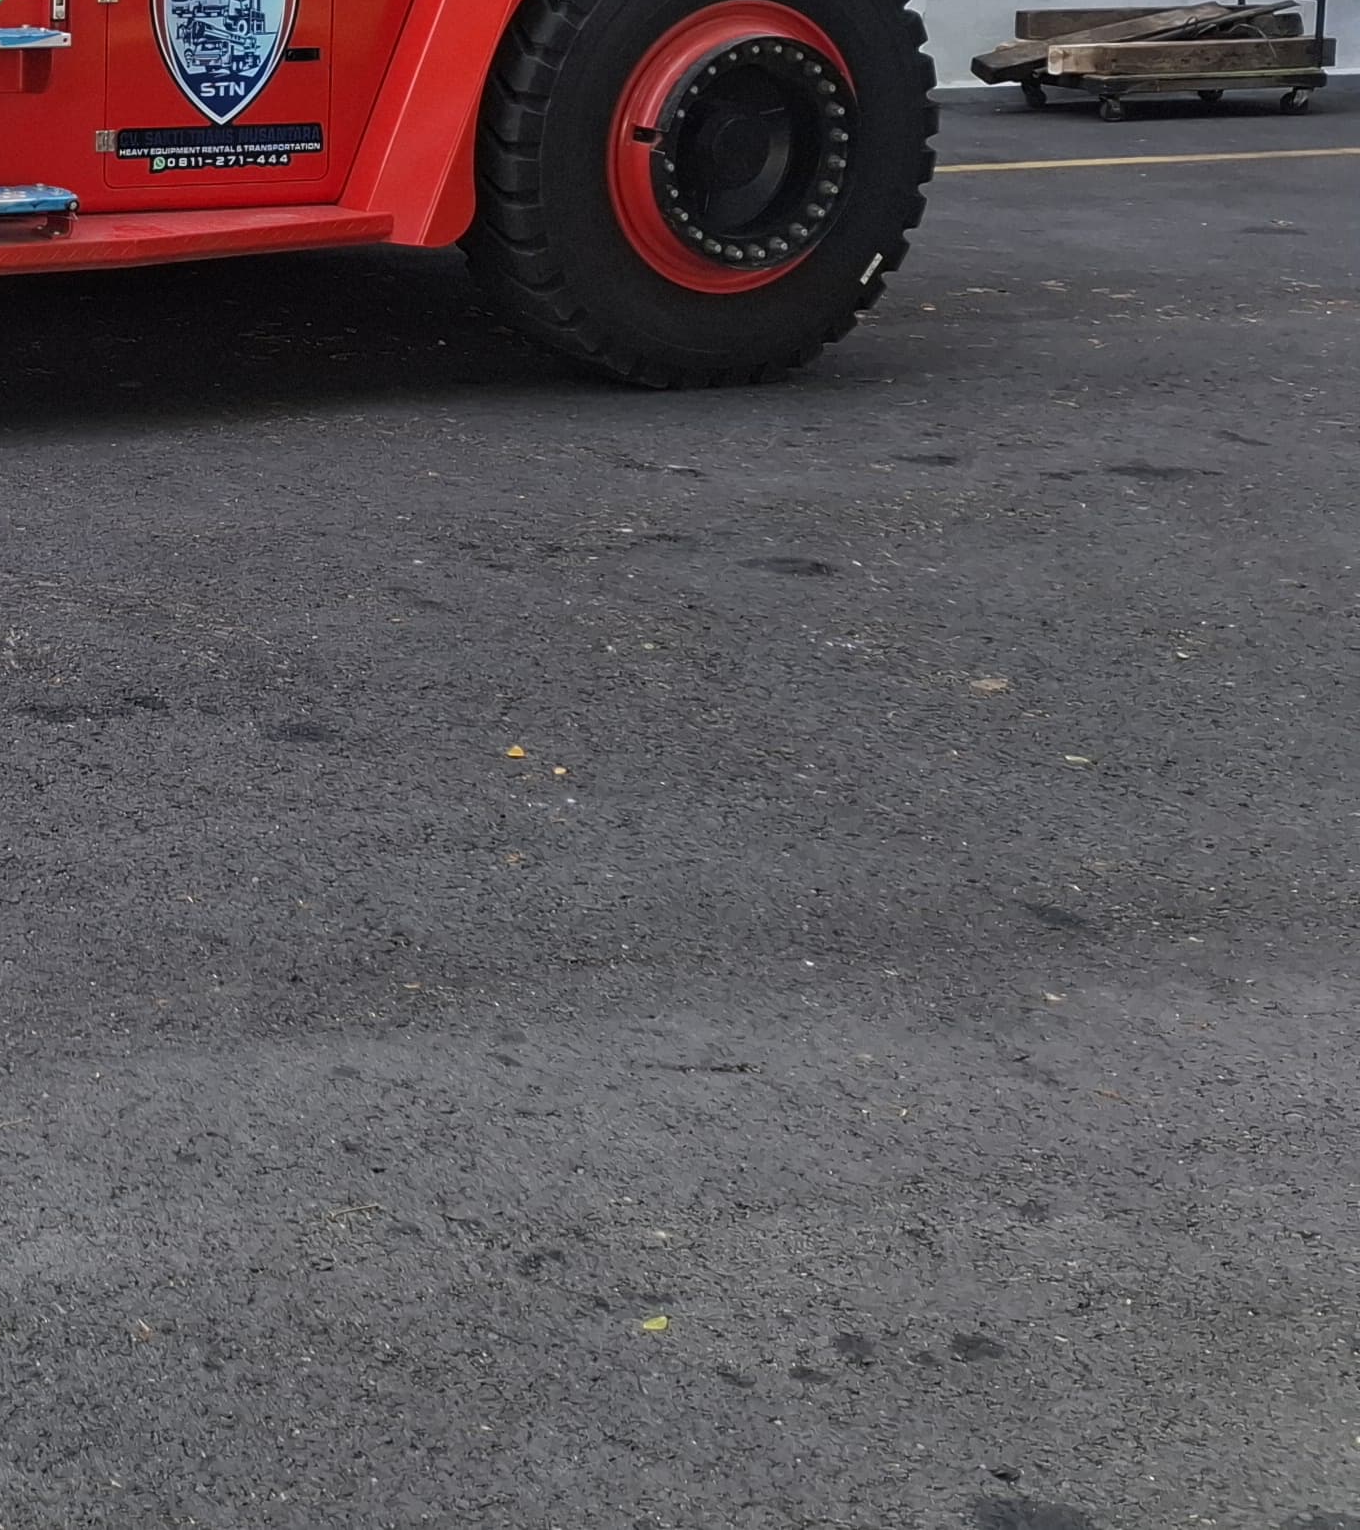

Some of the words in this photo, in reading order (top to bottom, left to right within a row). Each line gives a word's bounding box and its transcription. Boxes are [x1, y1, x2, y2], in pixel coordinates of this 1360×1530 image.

[200, 82, 245, 97] STN
[238, 126, 320, 143] NUSANTARA
[119, 148, 148, 157] HEAVY
[150, 146, 200, 155] EQUIPMENT
[201, 145, 235, 154] RENTAL
[244, 143, 320, 152] TRANSPORTATION
[167, 154, 289, 167] 0811-271-444
